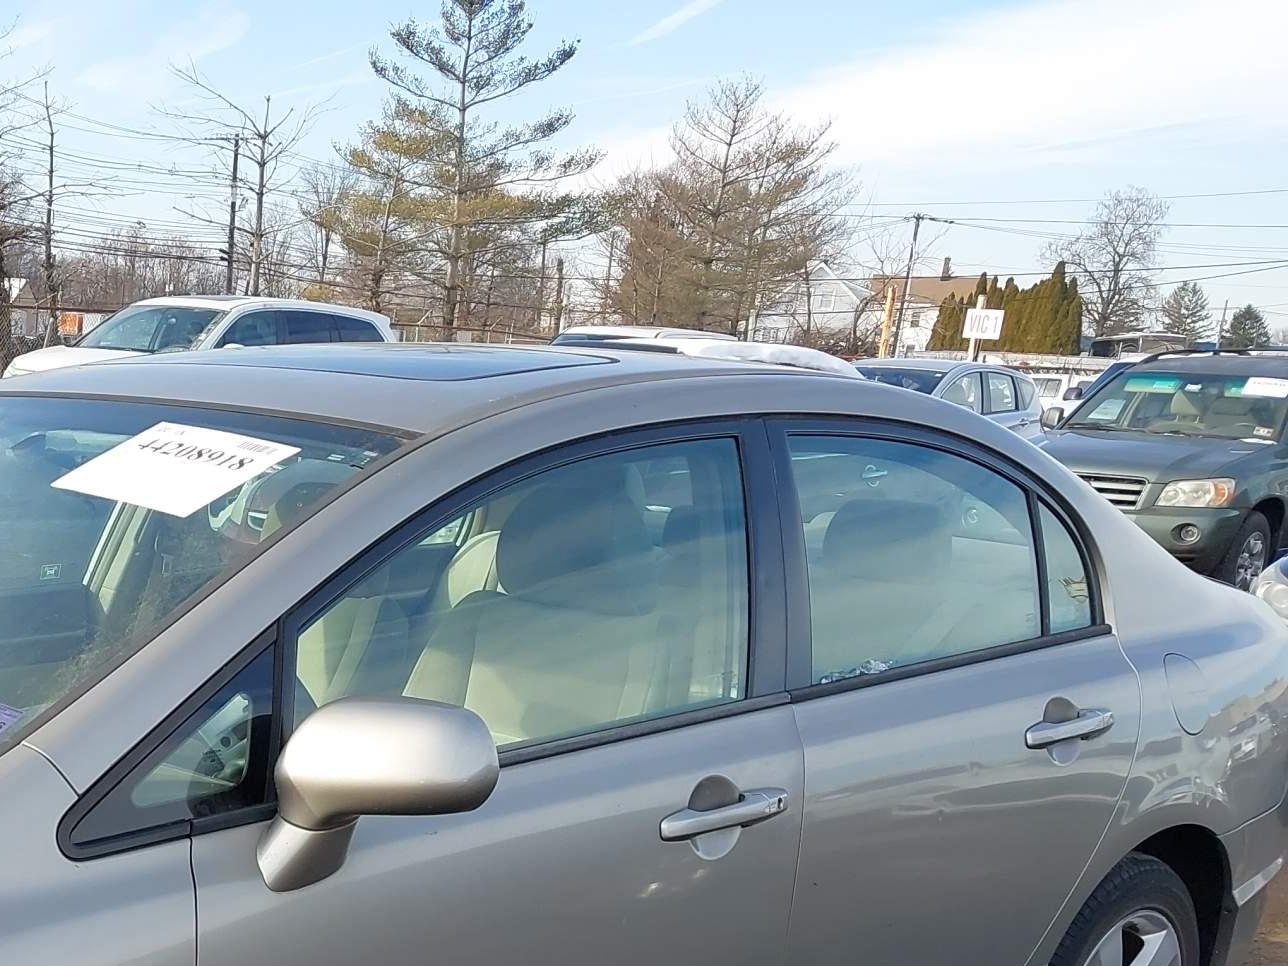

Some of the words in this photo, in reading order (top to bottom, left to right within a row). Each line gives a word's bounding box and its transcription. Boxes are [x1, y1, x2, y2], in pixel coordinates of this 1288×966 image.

[970, 314, 991, 334] VIC
[993, 315, 1000, 334] 1
[138, 439, 254, 470] 44208918
